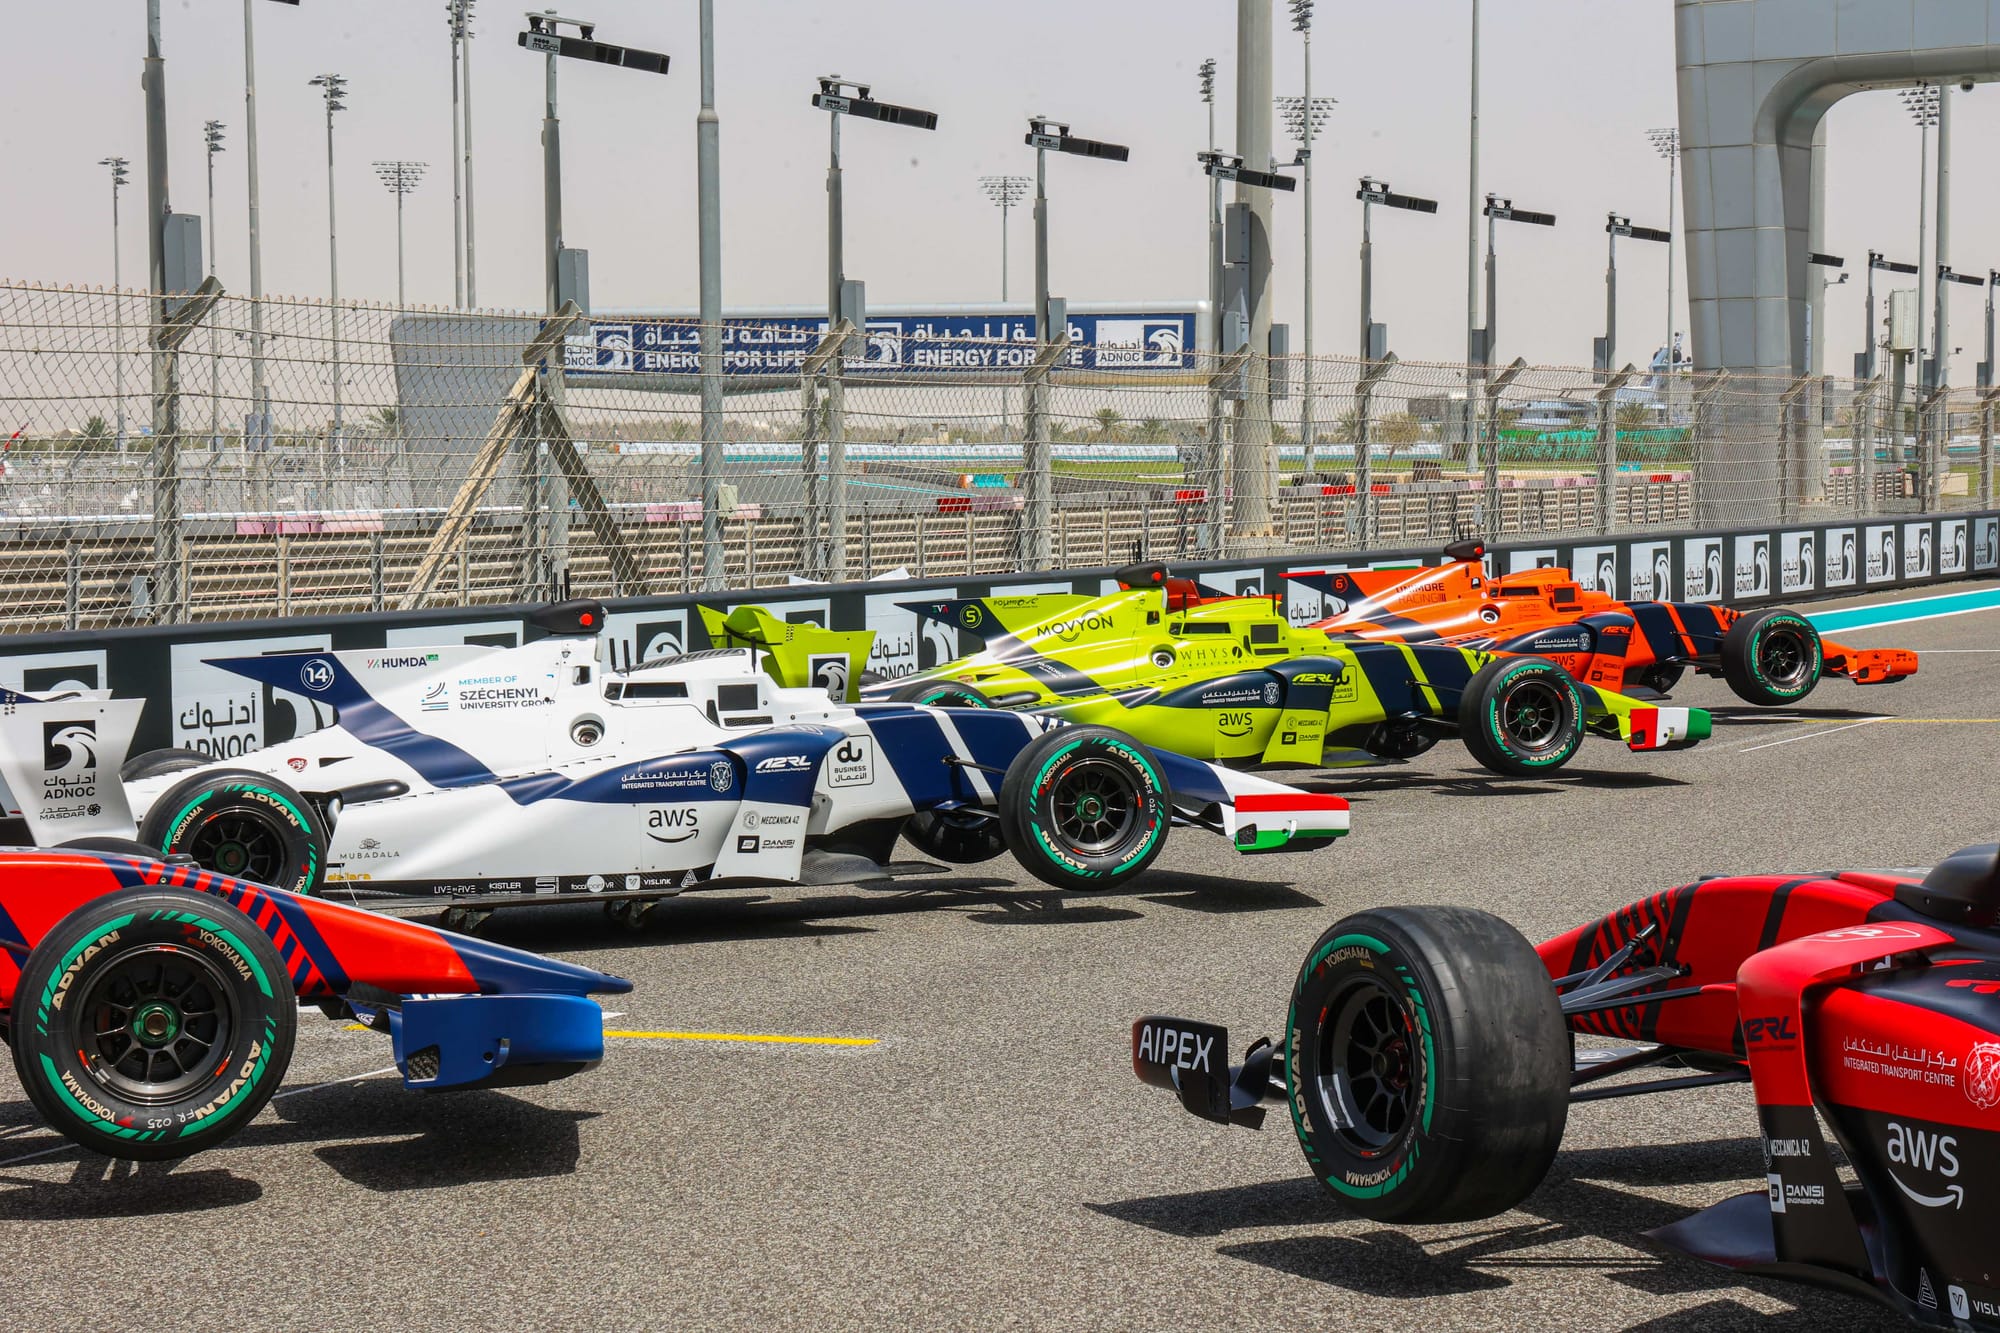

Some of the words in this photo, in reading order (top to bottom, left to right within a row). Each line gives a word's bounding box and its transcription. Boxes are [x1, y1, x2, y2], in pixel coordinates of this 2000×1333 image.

[565, 356, 593, 366] DNOC
[644, 352, 701, 369] ENER
[724, 350, 761, 368] FOR
[766, 349, 806, 368] LIFE
[914, 348, 993, 367] ENERGY
[996, 348, 1037, 366] FOR
[1100, 352, 1141, 362] ADNOC
[1335, 578, 1344, 589] 6
[1686, 583, 1705, 598] ADNOC
[1736, 579, 1753, 592] ADNOC
[1037, 615, 1113, 637] MOVYON
[382, 656, 427, 669] HUMDA
[306, 665, 331, 684] 14
[459, 677, 502, 686] MEMBER
[504, 675, 518, 683] OF
[1506, 668, 1543, 687] ADVAN
[460, 686, 539, 701] SZÉCHENYI
[180, 691, 256, 735] أدنوك
[460, 700, 519, 710] UNIVERSITY
[1219, 712, 1252, 727] aws
[1529, 743, 1567, 762] ADVAN
[834, 765, 867, 773] BUSINESS
[1041, 753, 1072, 785] YOKOHAMA
[1106, 746, 1152, 785] ADVAN
[43, 786, 96, 800] ADNOC
[621, 781, 654, 790] INTEGRATED
[655, 780, 686, 788] TRANSPORT
[39, 811, 85, 821] MASDAR
[241, 791, 299, 827] ADVAN
[648, 808, 698, 828] aws
[172, 805, 204, 845] YOKOHAMA
[340, 851, 400, 860] MUBADALA
[1041, 830, 1088, 869] ADVAN
[1121, 830, 1152, 863] YOKOHAMA
[643, 878, 672, 886] VISLINK
[199, 929, 253, 982] YOKOHAMA
[1324, 946, 1371, 968] YOKOHAMA
[52, 930, 121, 1011] ADVAN
[1138, 1024, 1214, 1073] AIPEX
[1892, 1045, 1925, 1063] النقل
[1927, 1051, 1957, 1071] مركز
[195, 1039, 262, 1120] ADVAN
[1843, 1056, 1879, 1073] INTEGRATED
[1881, 1063, 1922, 1081] TRANSPORT
[1924, 1070, 1955, 1087] CENTRE
[61, 1069, 117, 1123] YOKOHAMA
[1770, 1138, 1801, 1157] MECCANICA
[1887, 1122, 1959, 1177] aws
[1345, 1167, 1391, 1187] YOKOHAMA
[1786, 1184, 1825, 1198] DANISI
